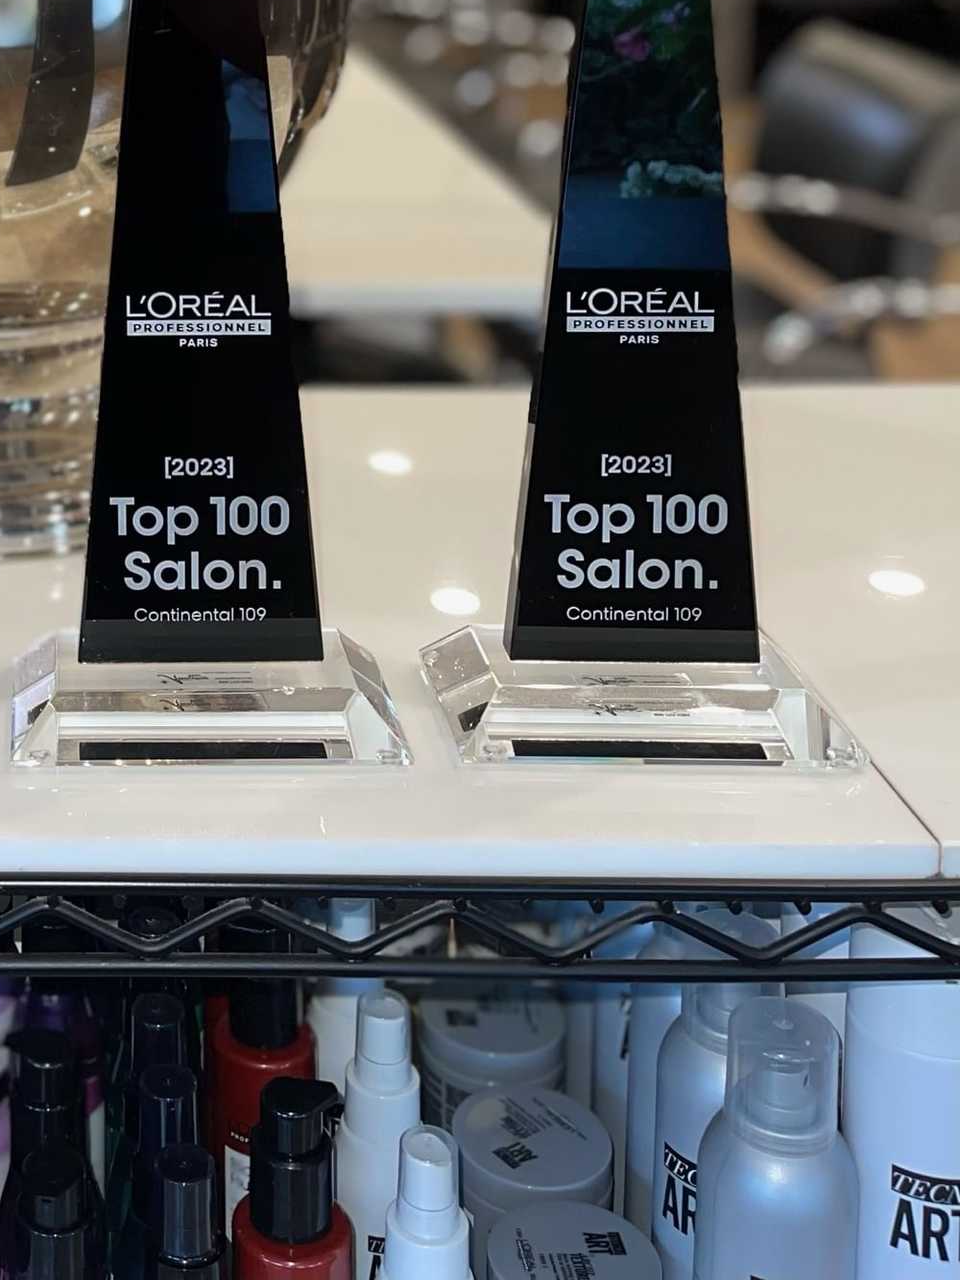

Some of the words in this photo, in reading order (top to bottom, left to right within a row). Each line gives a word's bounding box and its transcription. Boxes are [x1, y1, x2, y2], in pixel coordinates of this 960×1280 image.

[129, 320, 270, 335] PROFESSIONNEL
[568, 317, 713, 331] PROFESSIONNEL
[180, 338, 217, 347] PARIS
[620, 335, 659, 343] PARIS
[165, 457, 233, 479] [2023]
[602, 454, 671, 476] [2023]
[110, 497, 198, 545] Top
[210, 496, 289, 535] 100
[544, 494, 634, 543] Top
[647, 494, 727, 534] 100
[124, 551, 281, 590] Salon.
[557, 549, 717, 589] Salon.
[135, 608, 233, 621] Continental
[240, 608, 266, 621] 109
[567, 607, 668, 620] Continental
[675, 608, 701, 621] 109
